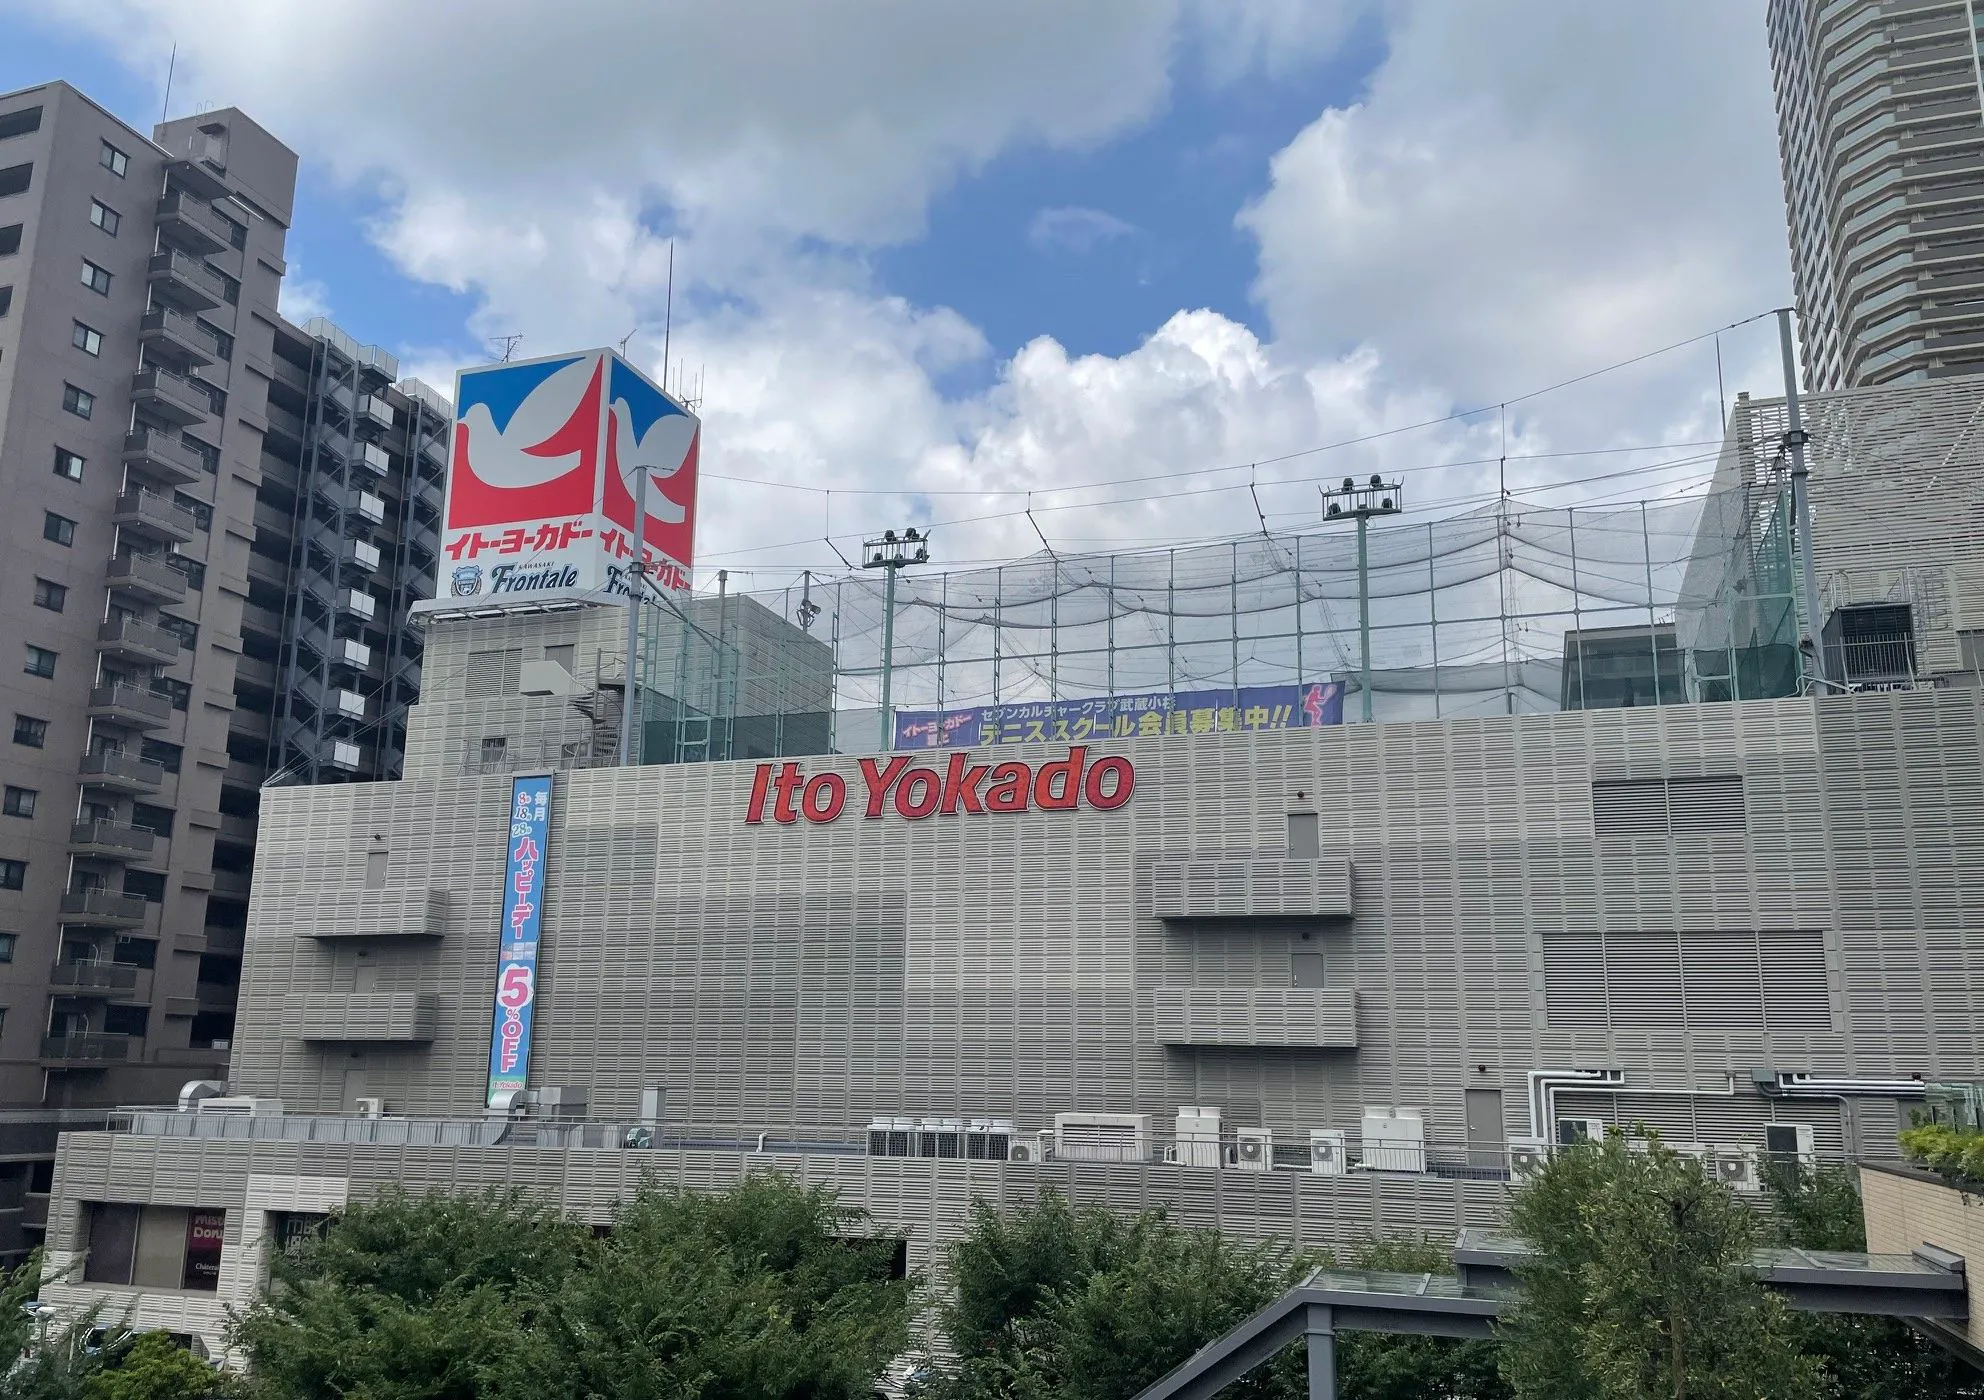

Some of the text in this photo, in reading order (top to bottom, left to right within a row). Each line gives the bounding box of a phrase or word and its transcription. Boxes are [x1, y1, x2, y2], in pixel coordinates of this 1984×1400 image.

[445, 521, 593, 560] イトーヨーカドー
[491, 562, 578, 594] Frontale
[744, 744, 1136, 825] Ito Yokado
[512, 837, 539, 939] ハッピーデー
